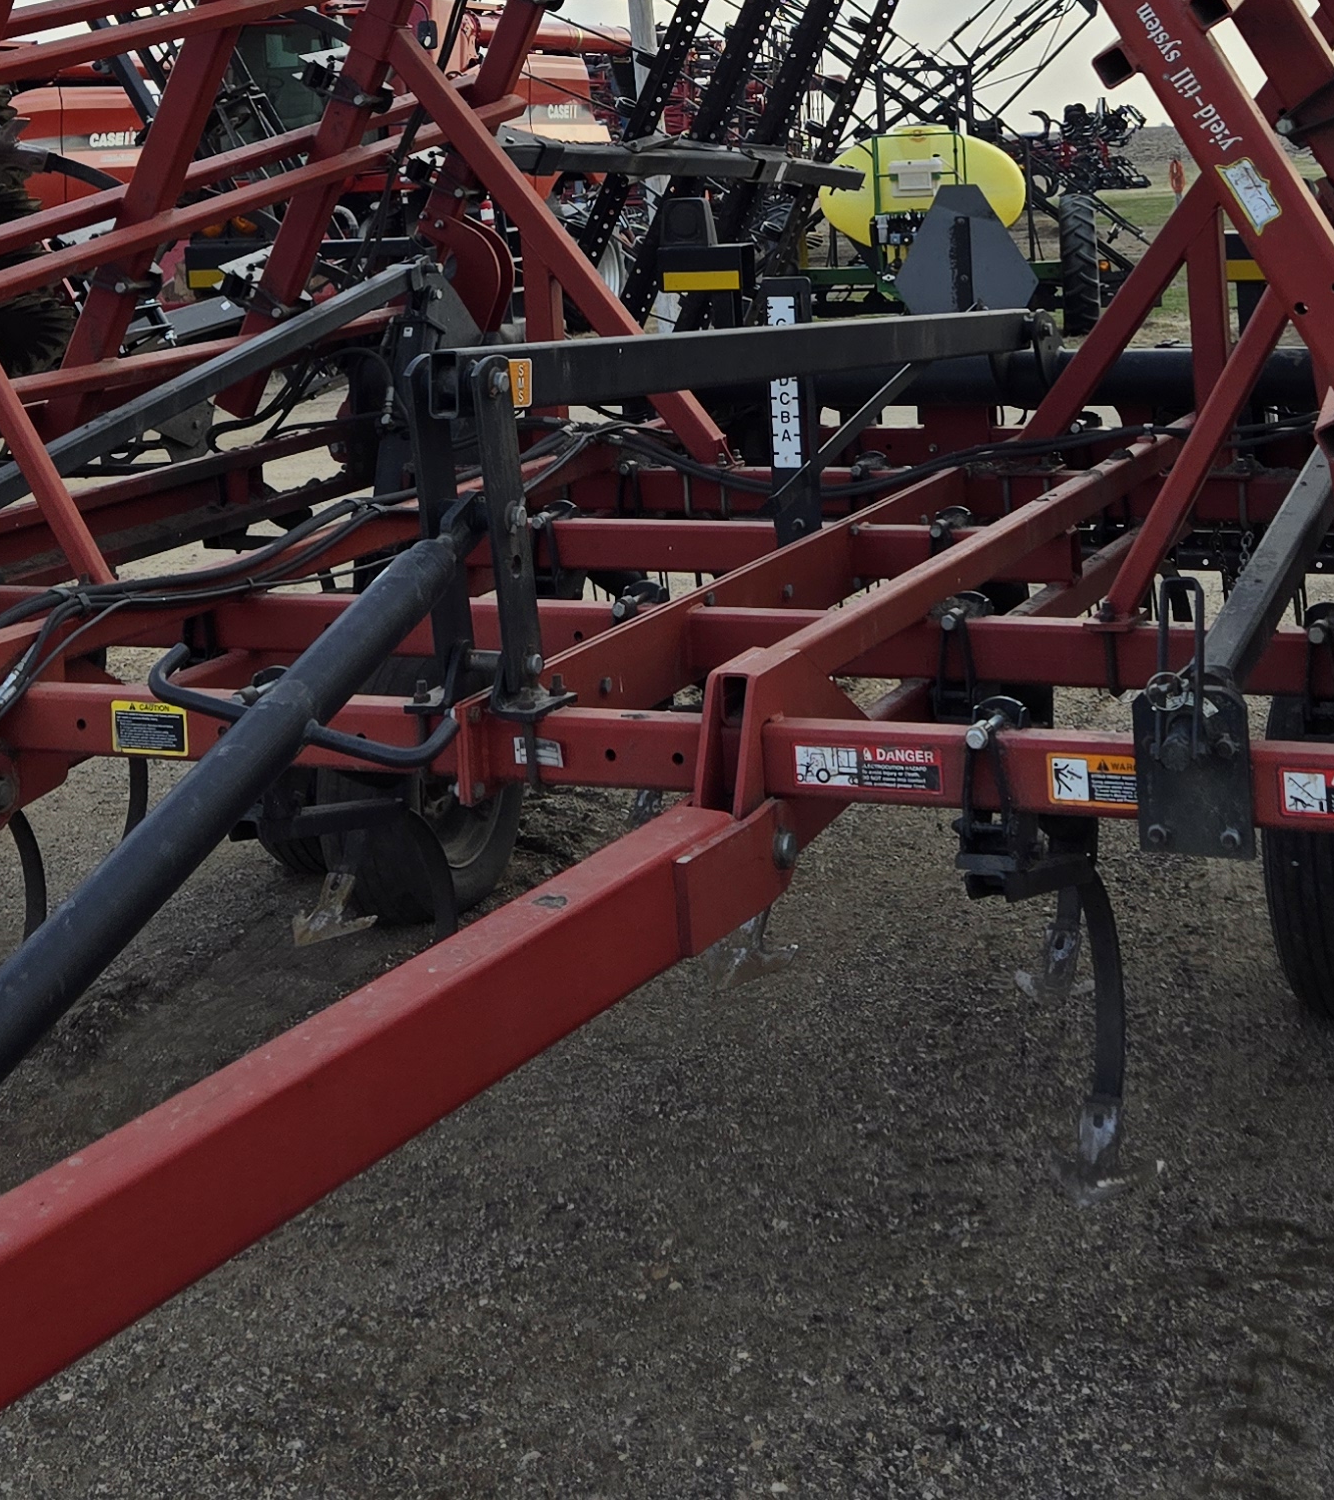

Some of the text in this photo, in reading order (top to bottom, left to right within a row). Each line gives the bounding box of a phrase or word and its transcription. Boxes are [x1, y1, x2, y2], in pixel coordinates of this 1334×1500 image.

[1135, 1, 1244, 152] yield-till system
[547, 103, 569, 119] CASE
[89, 131, 124, 148] CASE
[779, 392, 791, 405] C
[780, 411, 791, 424] B
[781, 429, 792, 442] A
[139, 703, 170, 712] CAUTION
[876, 747, 935, 763] DANGER
